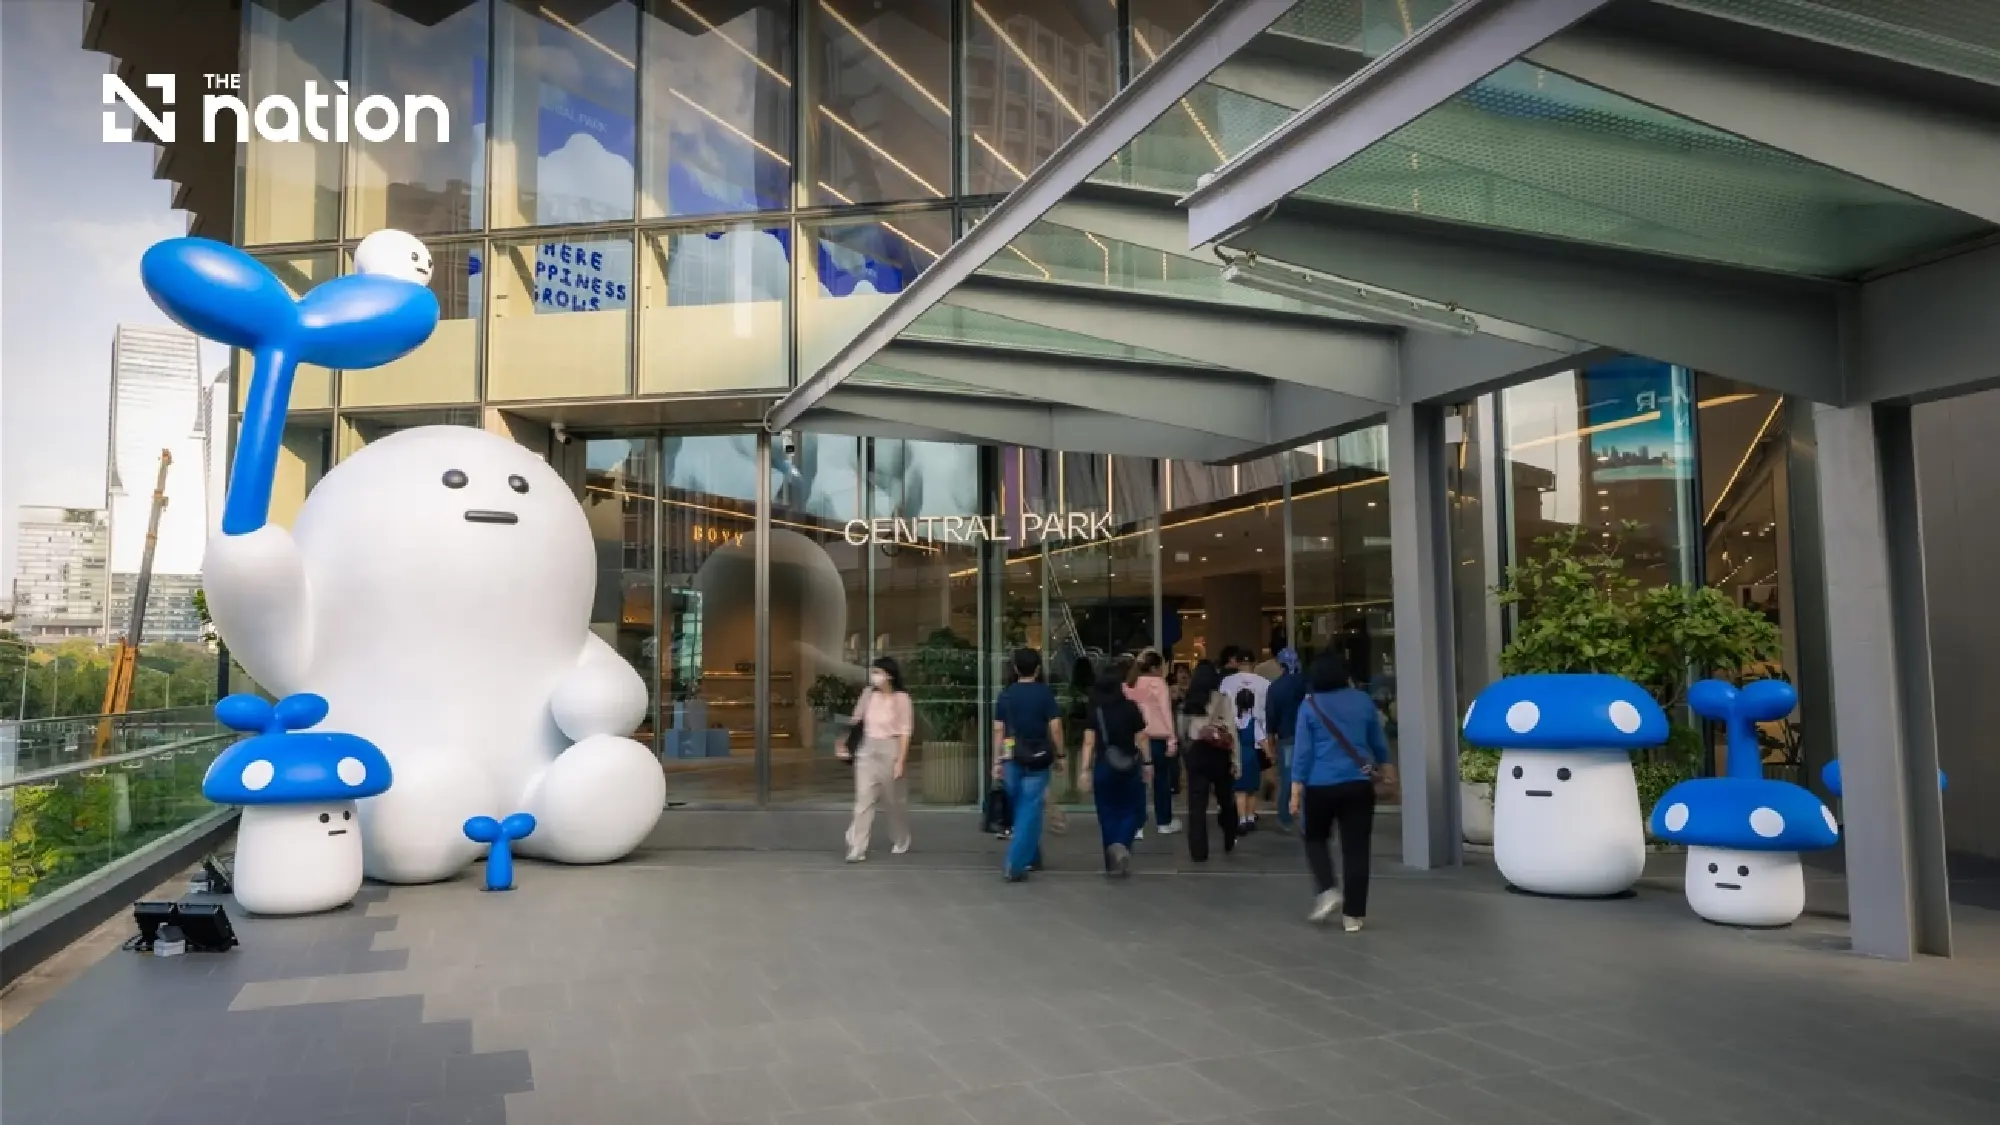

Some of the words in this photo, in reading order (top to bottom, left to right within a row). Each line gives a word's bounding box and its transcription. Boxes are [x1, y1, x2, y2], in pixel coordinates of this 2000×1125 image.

[536, 243, 603, 271] HERE
[844, 515, 1012, 545] CENTRAL
[1021, 511, 1112, 541] PARK
